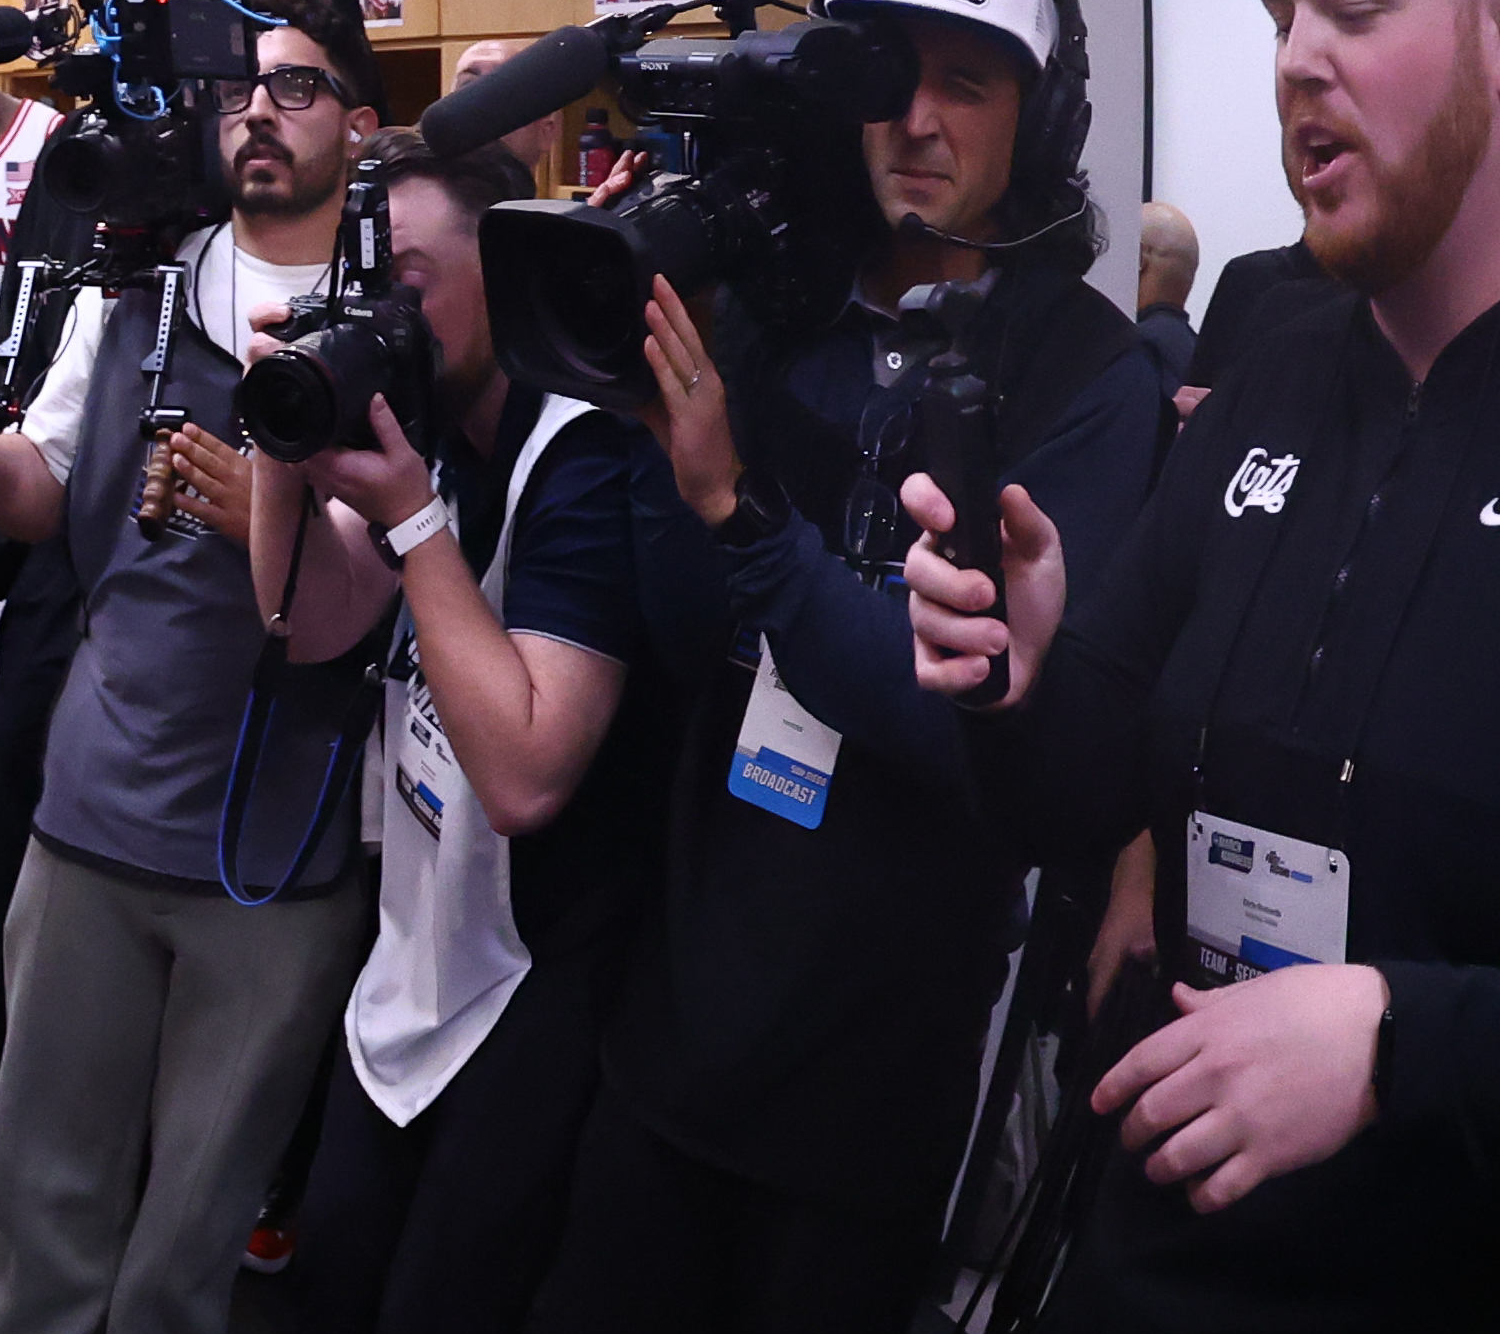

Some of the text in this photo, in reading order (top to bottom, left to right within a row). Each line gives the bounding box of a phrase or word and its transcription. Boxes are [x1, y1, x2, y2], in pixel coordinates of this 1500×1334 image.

[640, 62, 671, 71] SONY
[343, 306, 374, 318] Canon
[1224, 446, 1300, 517] Cats
[742, 762, 818, 806] BROADCAST
[1200, 946, 1228, 975] TEAM
